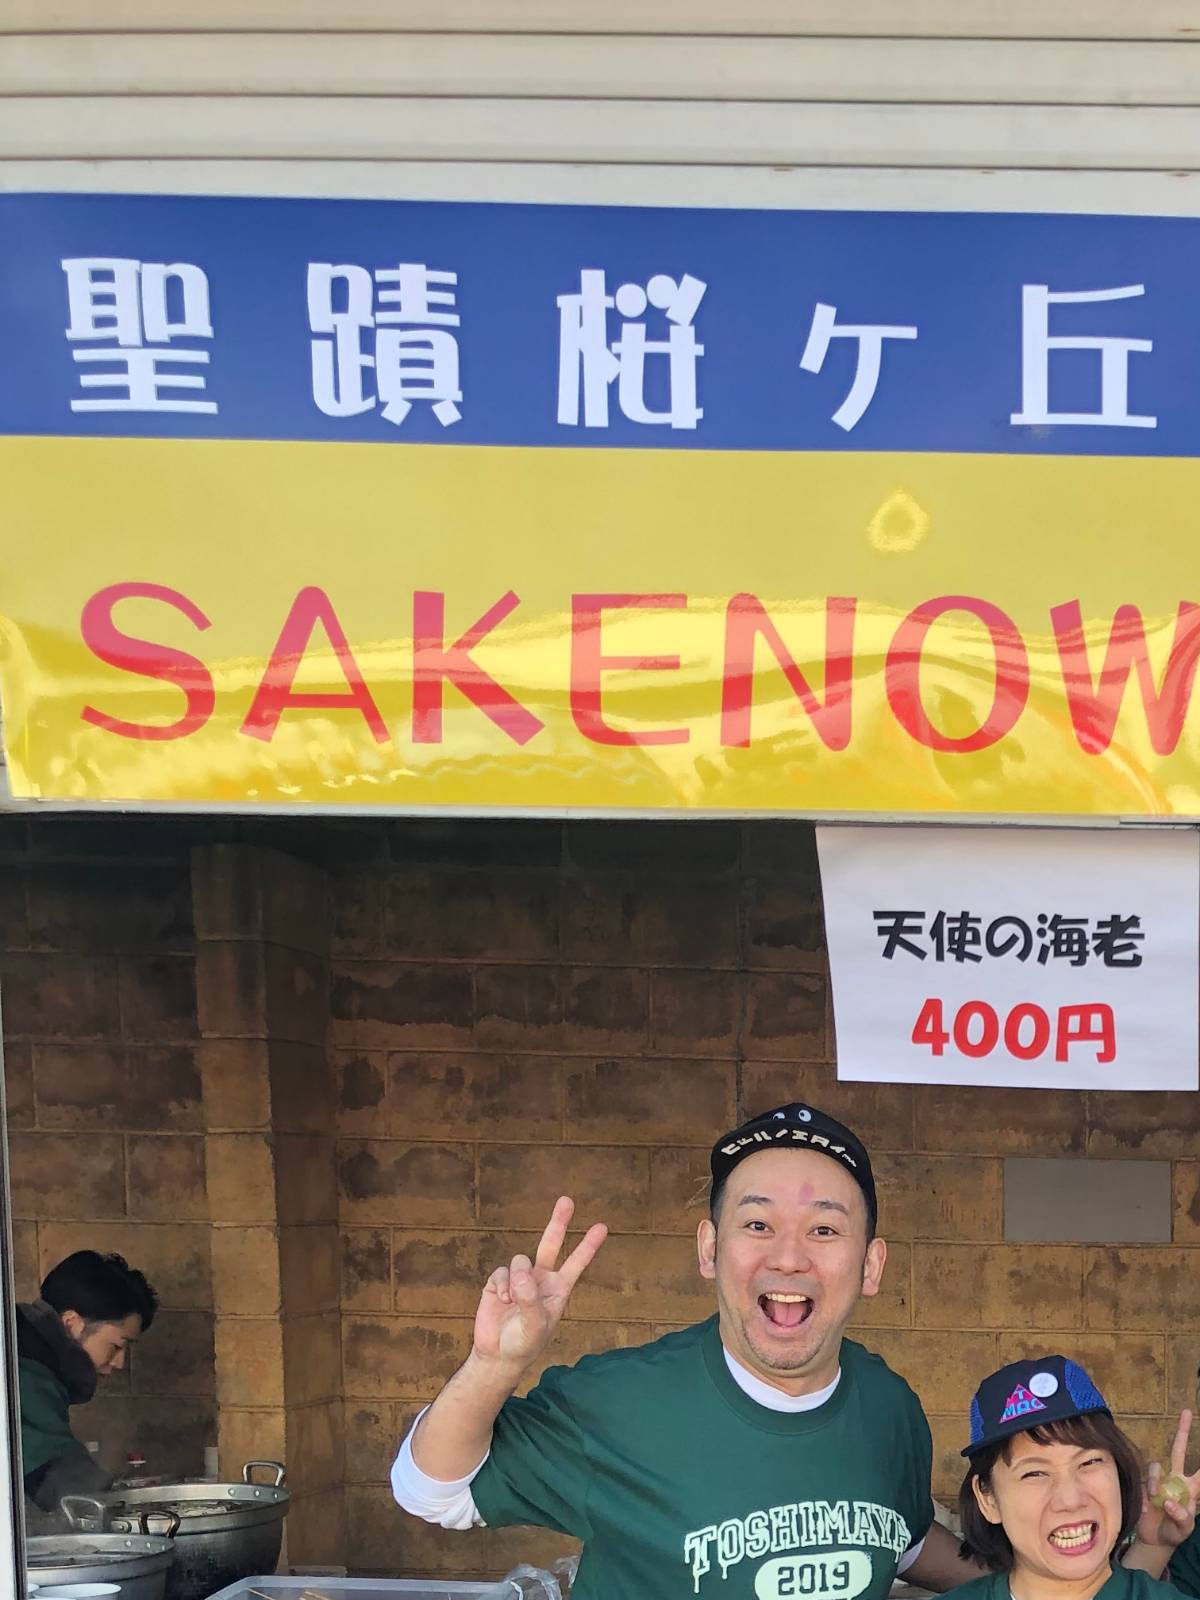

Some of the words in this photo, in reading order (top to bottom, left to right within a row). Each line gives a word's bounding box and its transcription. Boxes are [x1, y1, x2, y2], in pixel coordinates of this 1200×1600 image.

[872, 909, 1146, 968] 天使の海老
[911, 998, 1117, 1063] 400円
[684, 1500, 912, 1582] TOSHIMAYA
[776, 1560, 851, 1596] 2019
